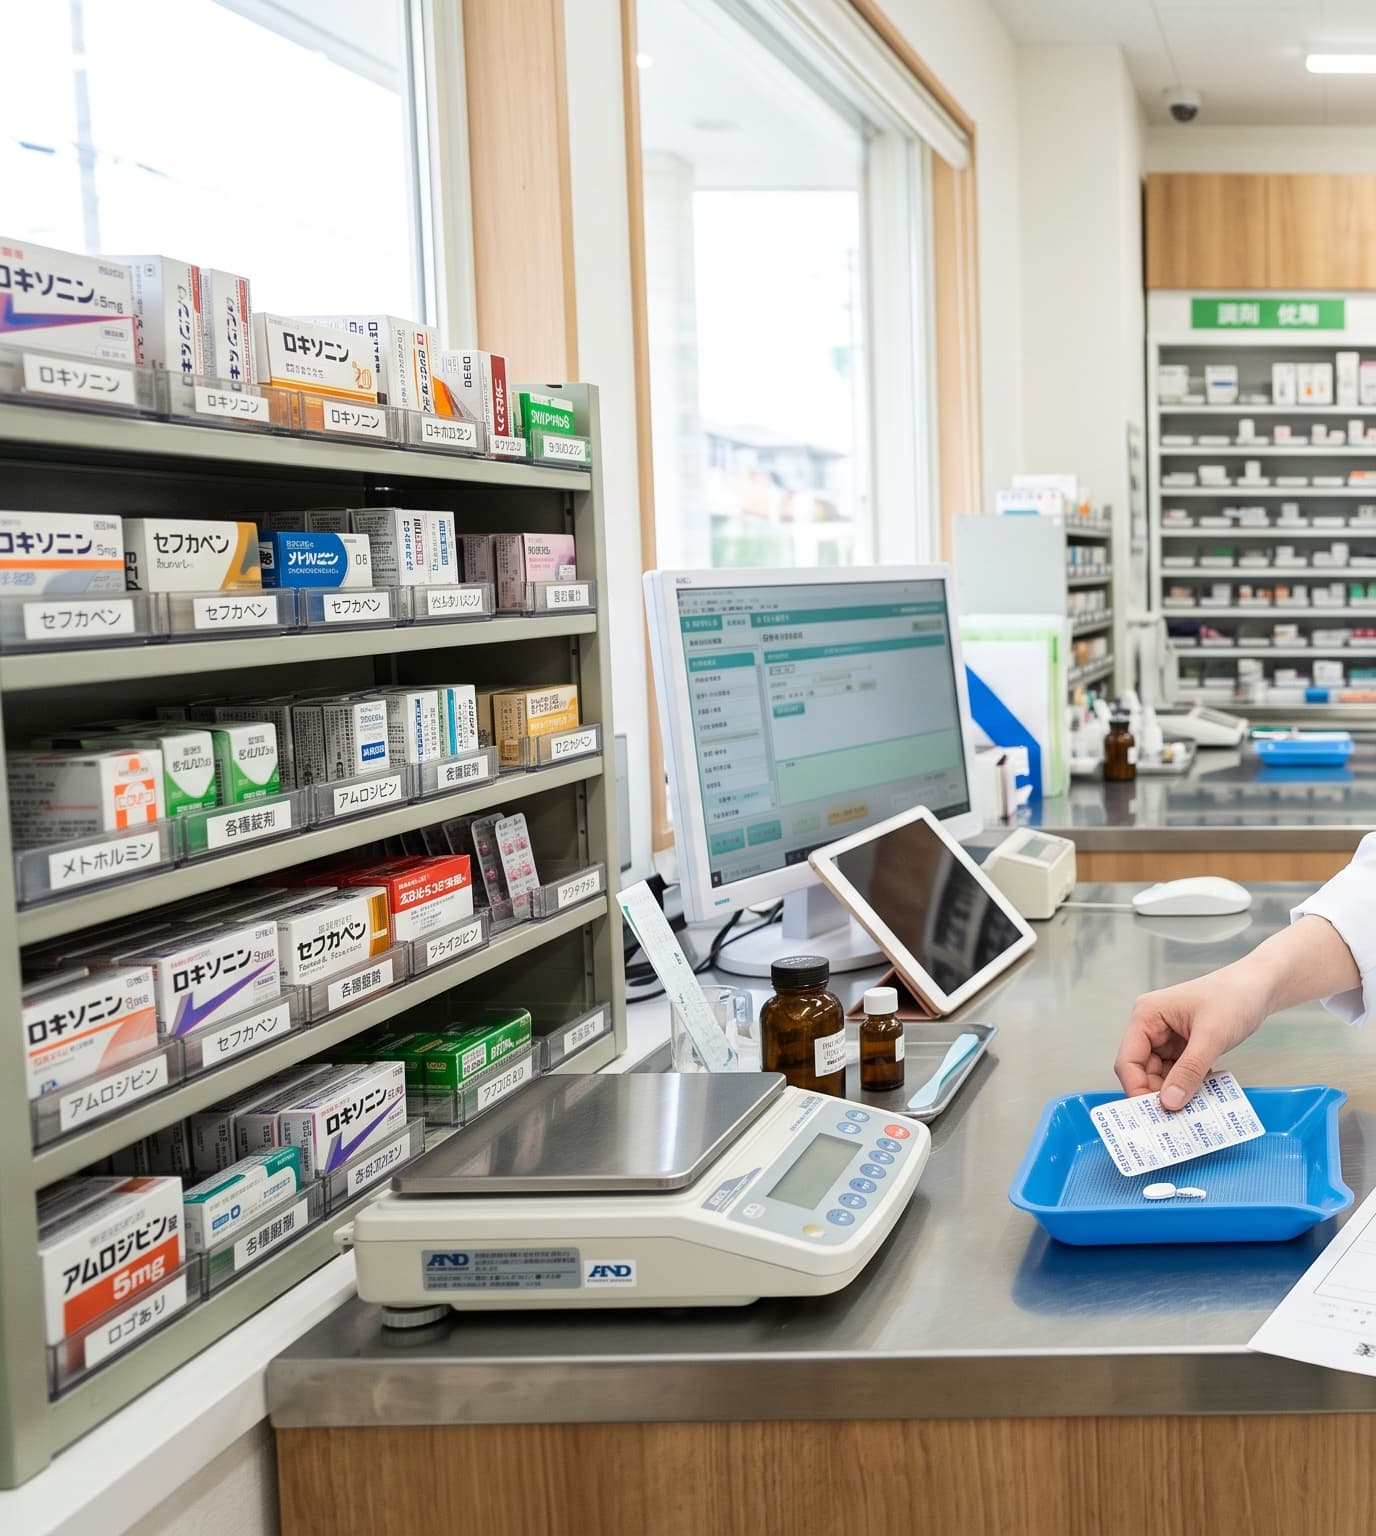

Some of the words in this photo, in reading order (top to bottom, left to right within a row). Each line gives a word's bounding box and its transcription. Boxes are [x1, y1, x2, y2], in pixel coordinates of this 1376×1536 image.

[283, 332, 349, 363] ロキソニン
[40, 366, 120, 392] ロキソニン
[331, 409, 380, 429] ロキソニン
[62, 842, 154, 878] メトホルミン
[172, 949, 252, 994] ロキソニン
[28, 996, 123, 1045] ロキソニン
[326, 1088, 387, 1136] ロキソニン
[112, 1255, 166, 1300] 5mg
[108, 1295, 166, 1345] ロゴあり
